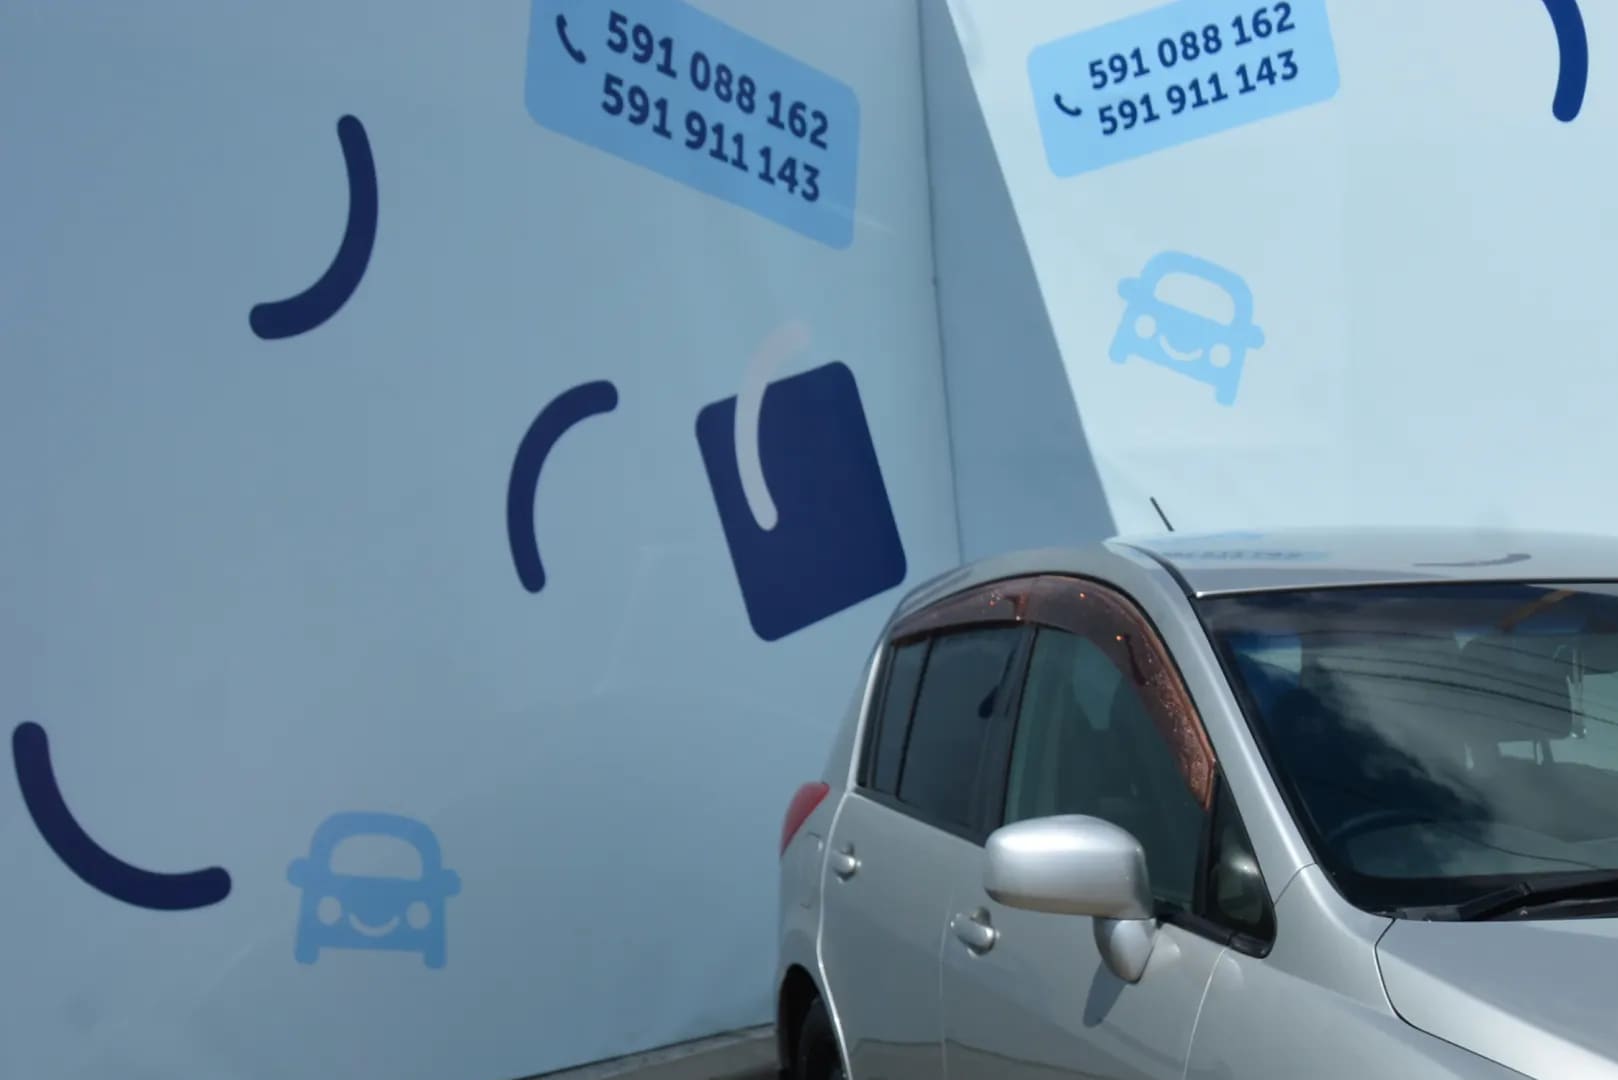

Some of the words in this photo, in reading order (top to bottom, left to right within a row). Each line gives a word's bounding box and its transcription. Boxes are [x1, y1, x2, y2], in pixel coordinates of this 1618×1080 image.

[606, 10, 677, 79] 591
[690, 51, 757, 115] 088
[766, 90, 829, 151] 162
[1088, 47, 1150, 91] 591
[1157, 23, 1223, 68] 088
[1230, 1, 1296, 47] 162
[1098, 93, 1161, 136] 591
[1165, 72, 1229, 115] 911
[1234, 49, 1299, 94] 143
[602, 72, 672, 140] 591
[684, 110, 749, 173] 911
[757, 146, 821, 202] 143
